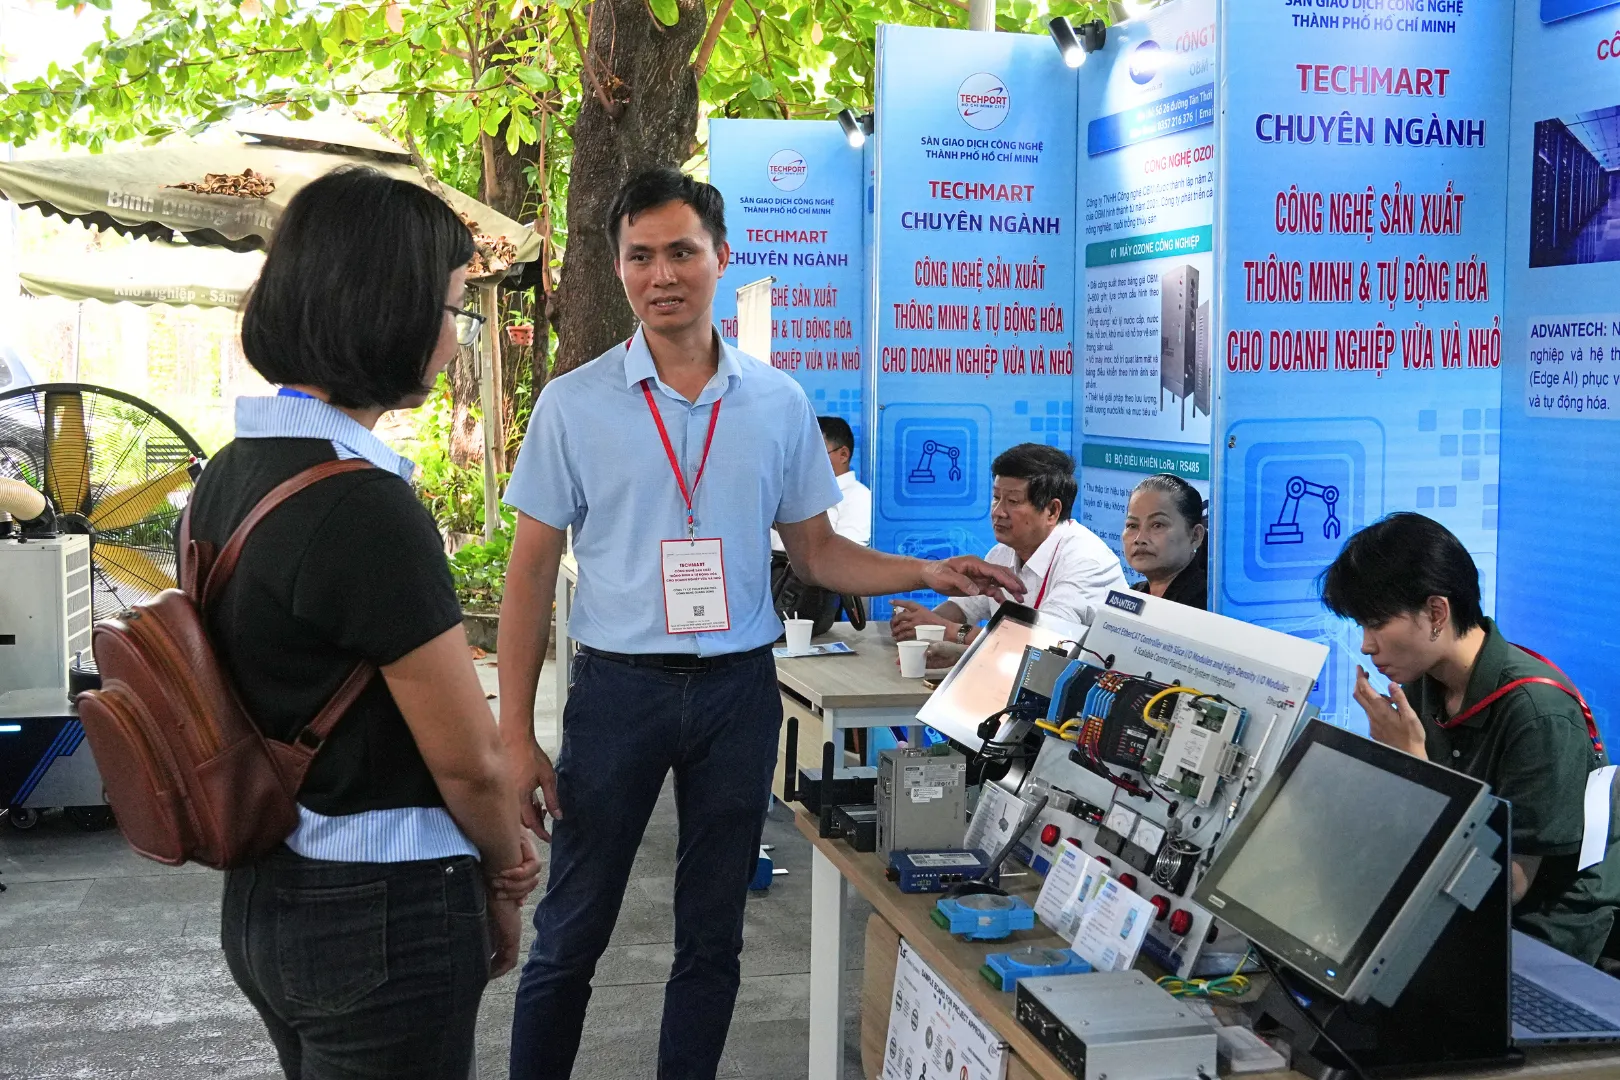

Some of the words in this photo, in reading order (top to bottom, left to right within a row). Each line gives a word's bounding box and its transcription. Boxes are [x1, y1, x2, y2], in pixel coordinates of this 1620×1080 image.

[1292, 12, 1339, 29] THÀNH
[1343, 13, 1370, 30] PHỐ
[1374, 14, 1395, 31] HỒ
[1396, 16, 1419, 32] CHÍ
[1421, 20, 1456, 33] MINH
[1296, 64, 1450, 97] TECHMART
[960, 94, 1007, 105] TECHPORT
[1256, 111, 1374, 144] CHUYÊN
[1384, 112, 1485, 147] NGÀNH
[921, 136, 940, 146] SÀN
[942, 138, 965, 147] GIAO
[967, 139, 989, 150] DỊCH
[991, 139, 1016, 150] CÔNG
[1018, 141, 1044, 153] NGHỆ
[926, 149, 958, 160] THÀNH
[960, 149, 980, 161] PHỐ
[981, 151, 995, 162] HỒ
[997, 153, 1012, 162] CHÍ
[1014, 154, 1038, 163] MINH
[1168, 147, 1192, 168] NGHỆ
[769, 165, 806, 173] TECHPORT
[775, 198, 792, 206] DỊCH
[793, 197, 814, 206] CÔNG
[929, 181, 1034, 202] TECHMART
[744, 206, 769, 214] THÀNH
[770, 206, 786, 214] PHỐ
[798, 206, 811, 215] CHÍ
[1275, 184, 1322, 234] CÔNG
[1329, 186, 1374, 242] NGHỆ
[1379, 181, 1415, 235] SẢN
[1420, 180, 1464, 235] XUẤT
[901, 210, 982, 232] CHUYÊN
[989, 212, 1060, 234] NGÀNH
[746, 229, 828, 243] TECHMART
[1110, 248, 1117, 258] 01
[1120, 243, 1132, 258] MÁY
[1133, 241, 1154, 256] OZONE
[1155, 237, 1174, 252] CÔNG
[1175, 235, 1200, 251] NGHIỆP
[729, 250, 788, 266] CHUYÊN
[793, 251, 848, 267] NGÀNH
[915, 255, 947, 287] CÔNG
[951, 258, 983, 293] NGHỆ
[987, 255, 1011, 289] SẢN
[1014, 255, 1046, 290] XUẤT
[1244, 253, 1302, 303] THÔNG
[1309, 261, 1353, 302] MINH
[1358, 262, 1371, 302] &
[1377, 257, 1400, 310] TỰ
[1404, 254, 1449, 310] ĐỘNG
[1455, 255, 1488, 302] HÓA
[771, 284, 789, 312] GHỆ
[792, 283, 811, 307] SẢN
[814, 282, 838, 307] XUẤT
[721, 315, 738, 338] THÔ
[781, 320, 788, 338] &
[791, 317, 803, 342] TỰ
[806, 316, 831, 342] ĐỘNG
[834, 316, 852, 339] HÓA
[893, 299, 933, 330] THÔNG
[938, 304, 969, 331] MINH
[972, 306, 981, 332] &
[985, 302, 1000, 336] TỰ
[1004, 301, 1036, 337] ĐỘNG
[1040, 302, 1064, 332] HÓA
[1530, 321, 1607, 338] ADVANTECH:
[1612, 321, 1620, 336] N
[1227, 330, 1263, 372] CHO
[1269, 329, 1328, 371] DOANH
[1335, 321, 1395, 378] NGHIỆP
[1401, 321, 1434, 369] VỪA
[1441, 320, 1461, 369] VÀ
[1468, 315, 1502, 369] NHỎ
[1530, 347, 1564, 365] nghiệp
[1570, 347, 1583, 361] và
[1590, 346, 1604, 363] hệ
[804, 347, 822, 370] VỪA
[826, 348, 838, 370] VÀ
[841, 345, 860, 370] NHỎ
[882, 346, 907, 373] CHO
[911, 347, 951, 374] DOANH
[956, 344, 998, 379] NGHIỆP
[1002, 343, 1025, 374] VỪA
[1030, 344, 1046, 374] VÀ
[1049, 342, 1074, 375] NHỎ
[1529, 370, 1560, 388] (Edge
[1562, 370, 1578, 388] AI)
[1582, 371, 1609, 388] phục
[1529, 394, 1541, 408] và
[1543, 395, 1555, 411] tự
[1557, 394, 1583, 413] động
[1586, 395, 1610, 410] hóa.
[1114, 454, 1123, 467] BỘ
[1124, 454, 1138, 467] ĐIỀU
[1140, 455, 1158, 469] KHIỂN
[1159, 458, 1175, 471] LoRa
[1180, 460, 1200, 473] RS485
[1102, 621, 1121, 635] Compact
[1120, 625, 1141, 641] EtherCAT
[1140, 634, 1162, 649] Controller
[1162, 641, 1174, 652] with
[1193, 651, 1213, 667] Modules
[1212, 659, 1223, 670] and
[1222, 661, 1256, 684] High-Density
[1266, 676, 1290, 693] Modules
[1136, 646, 1154, 660] Scalable
[1153, 652, 1169, 665] Control
[1168, 658, 1187, 671] Platform
[1186, 664, 1194, 674] for
[1193, 667, 1211, 680] System
